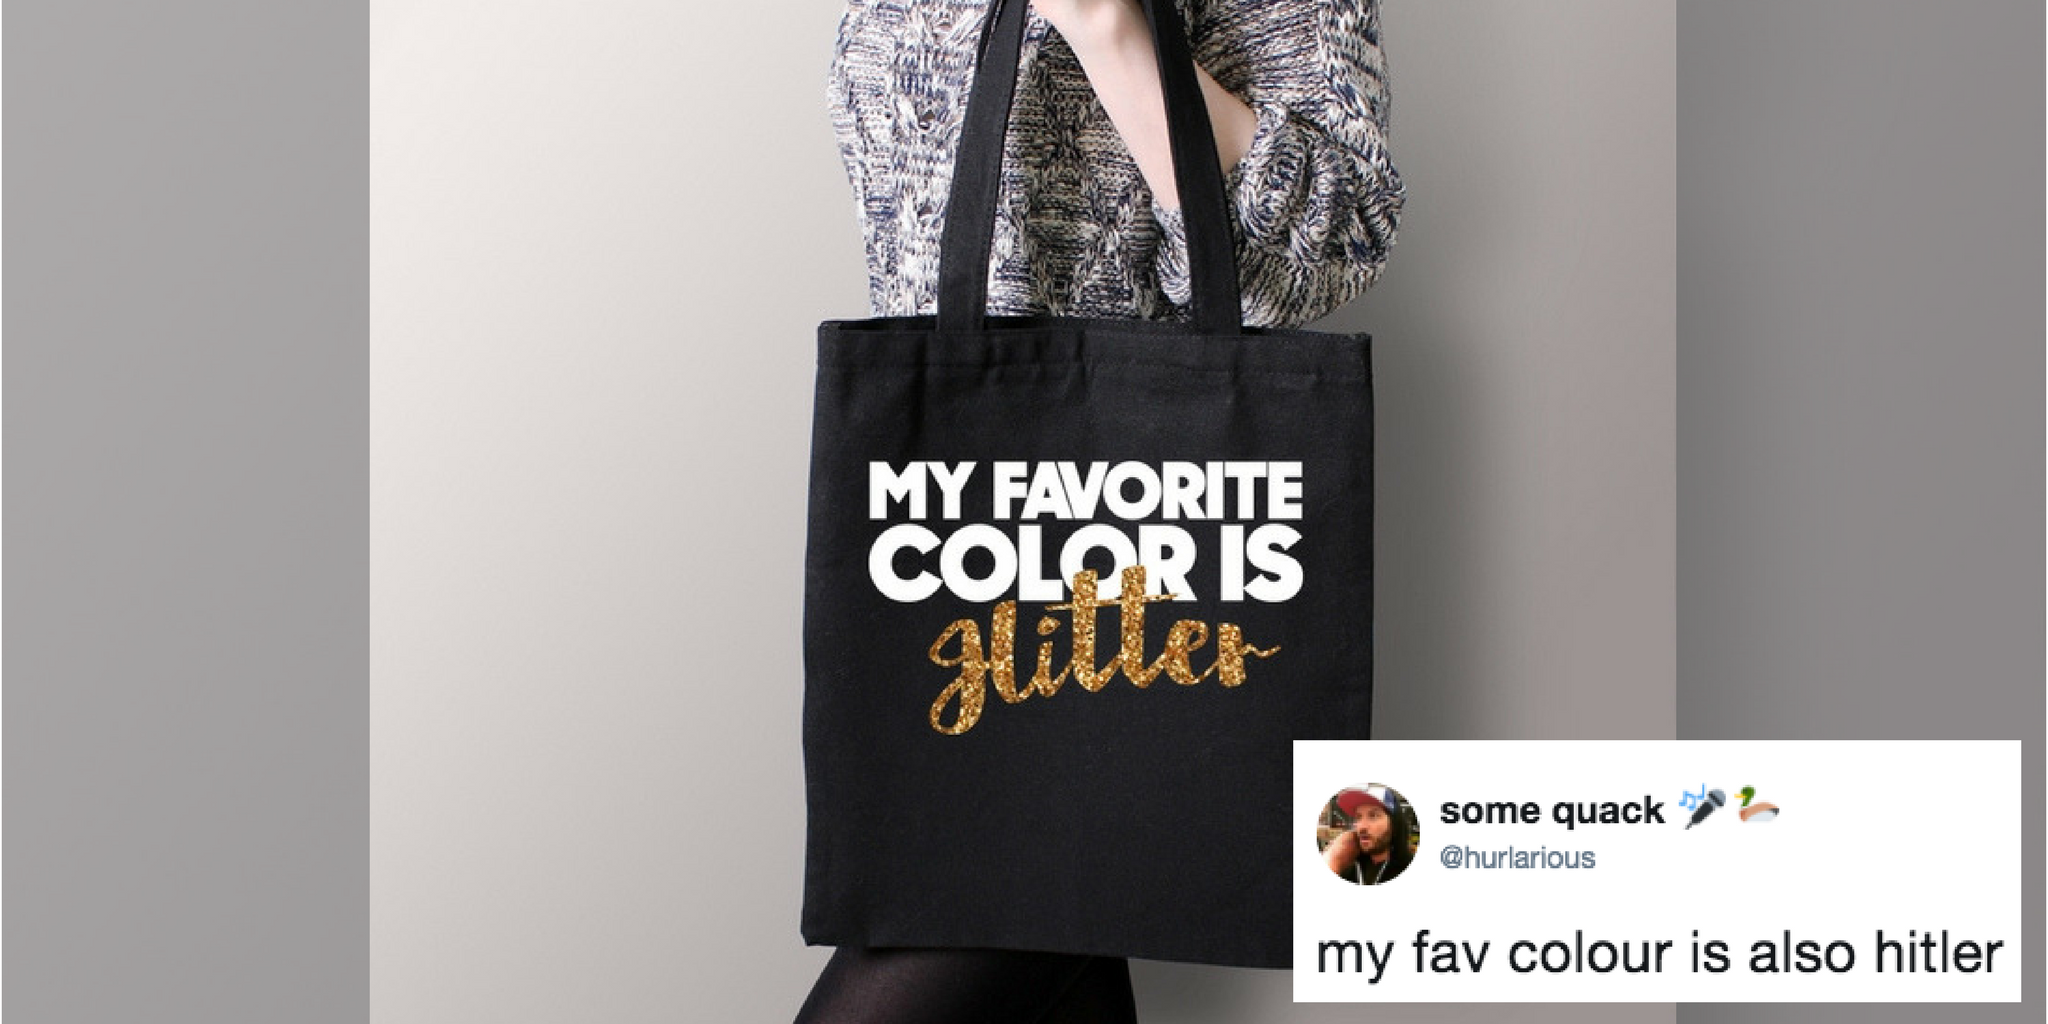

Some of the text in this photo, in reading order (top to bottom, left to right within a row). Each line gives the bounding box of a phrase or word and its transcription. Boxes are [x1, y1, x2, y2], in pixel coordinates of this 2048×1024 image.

[869, 460, 1303, 521] MY FAVORITE
[868, 523, 1304, 602] COLOR IS
[928, 564, 1282, 735] glitter
